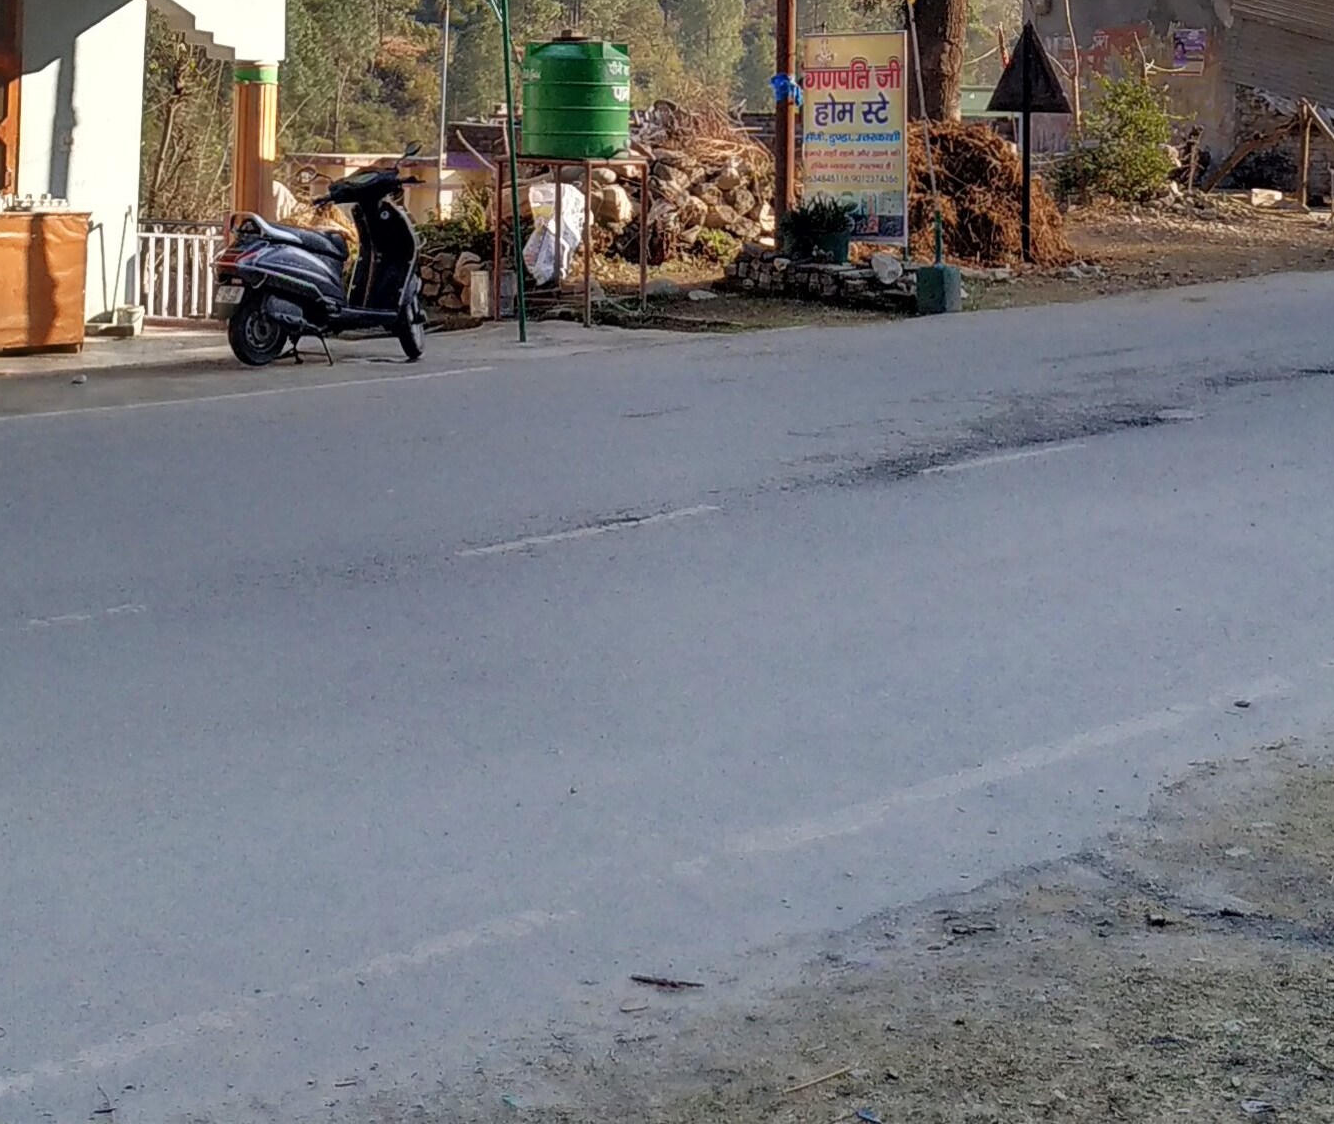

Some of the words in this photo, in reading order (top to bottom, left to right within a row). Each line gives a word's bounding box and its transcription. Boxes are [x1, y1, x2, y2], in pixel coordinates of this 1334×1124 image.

[804, 59, 871, 90] गणपति
[875, 58, 902, 89] जी
[814, 92, 855, 126] होम
[861, 91, 889, 124] स्टे
